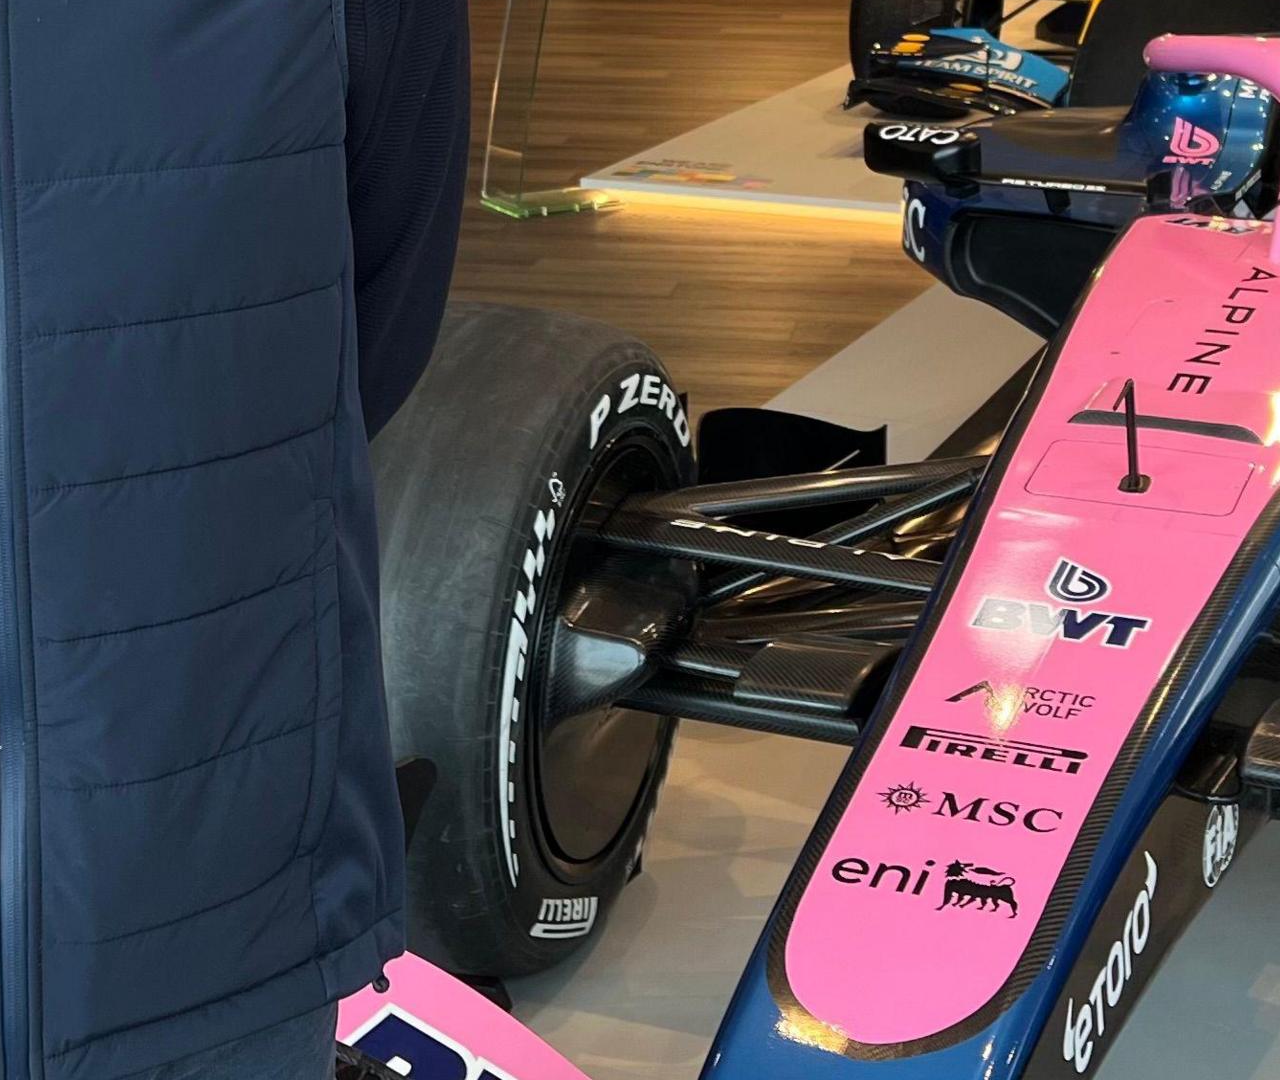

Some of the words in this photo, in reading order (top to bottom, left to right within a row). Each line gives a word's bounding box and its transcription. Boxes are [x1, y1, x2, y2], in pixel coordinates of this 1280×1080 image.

[973, 65, 1037, 89] SPIRIT
[1166, 266, 1280, 395] ALPINE
[589, 393, 611, 451] P
[617, 373, 691, 448] ZERO
[971, 597, 1150, 649] BWT
[899, 725, 1089, 775] PIRELLI
[931, 791, 1063, 833] MSC
[831, 858, 937, 896] eni
[529, 896, 598, 939] PIRELLI
